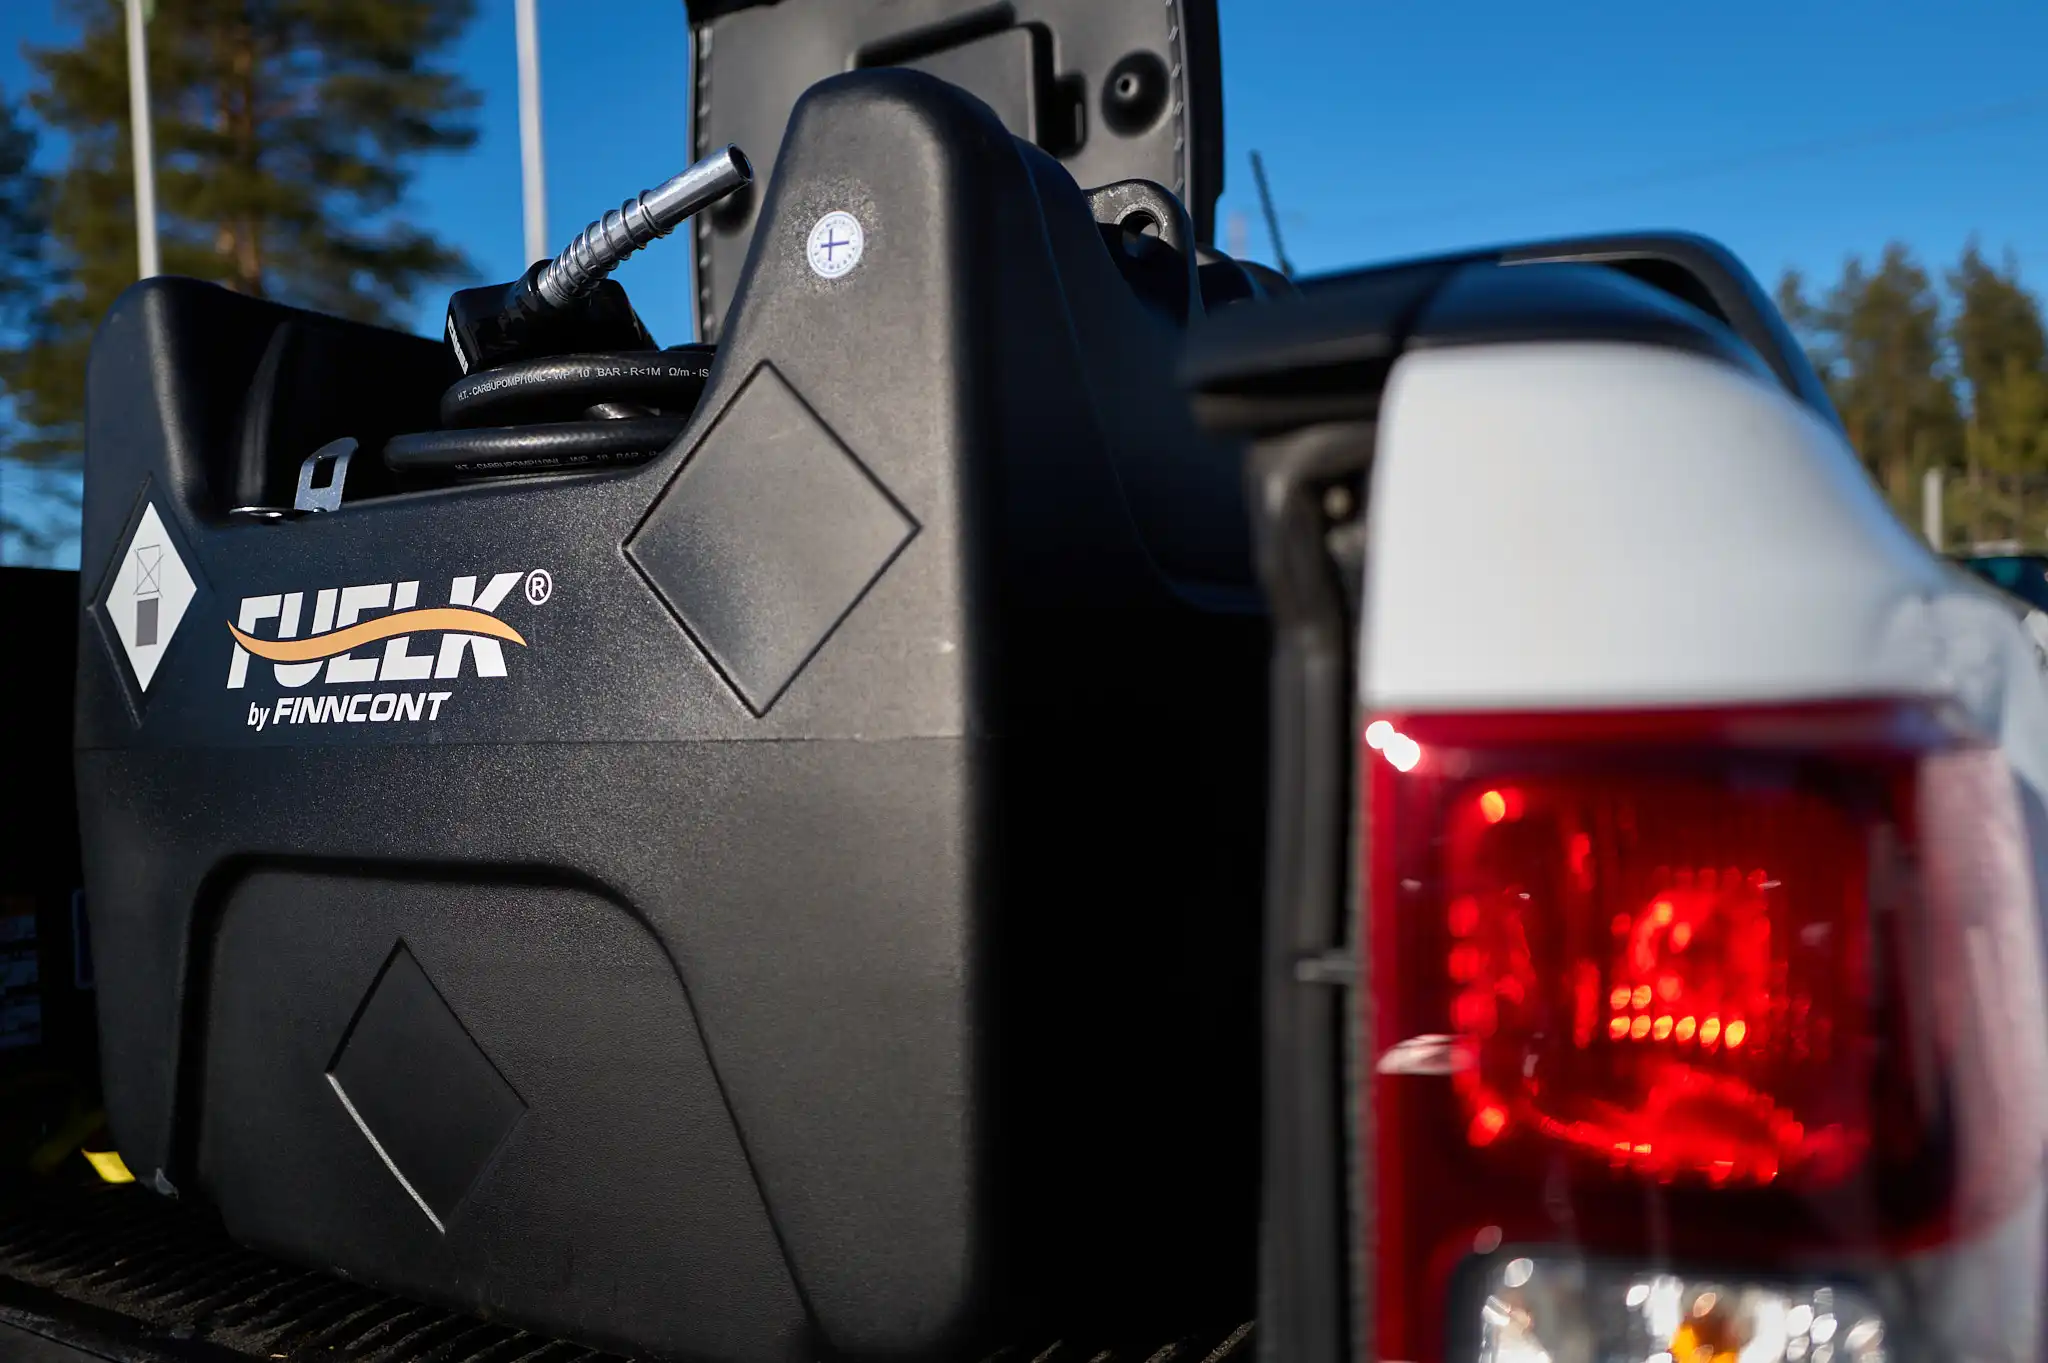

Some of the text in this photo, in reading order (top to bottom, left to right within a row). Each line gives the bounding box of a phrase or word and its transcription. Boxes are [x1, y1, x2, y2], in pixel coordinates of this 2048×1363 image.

[578, 368, 590, 378] 10
[598, 367, 621, 377] BAR
[247, 691, 452, 732] by FINNCONT
